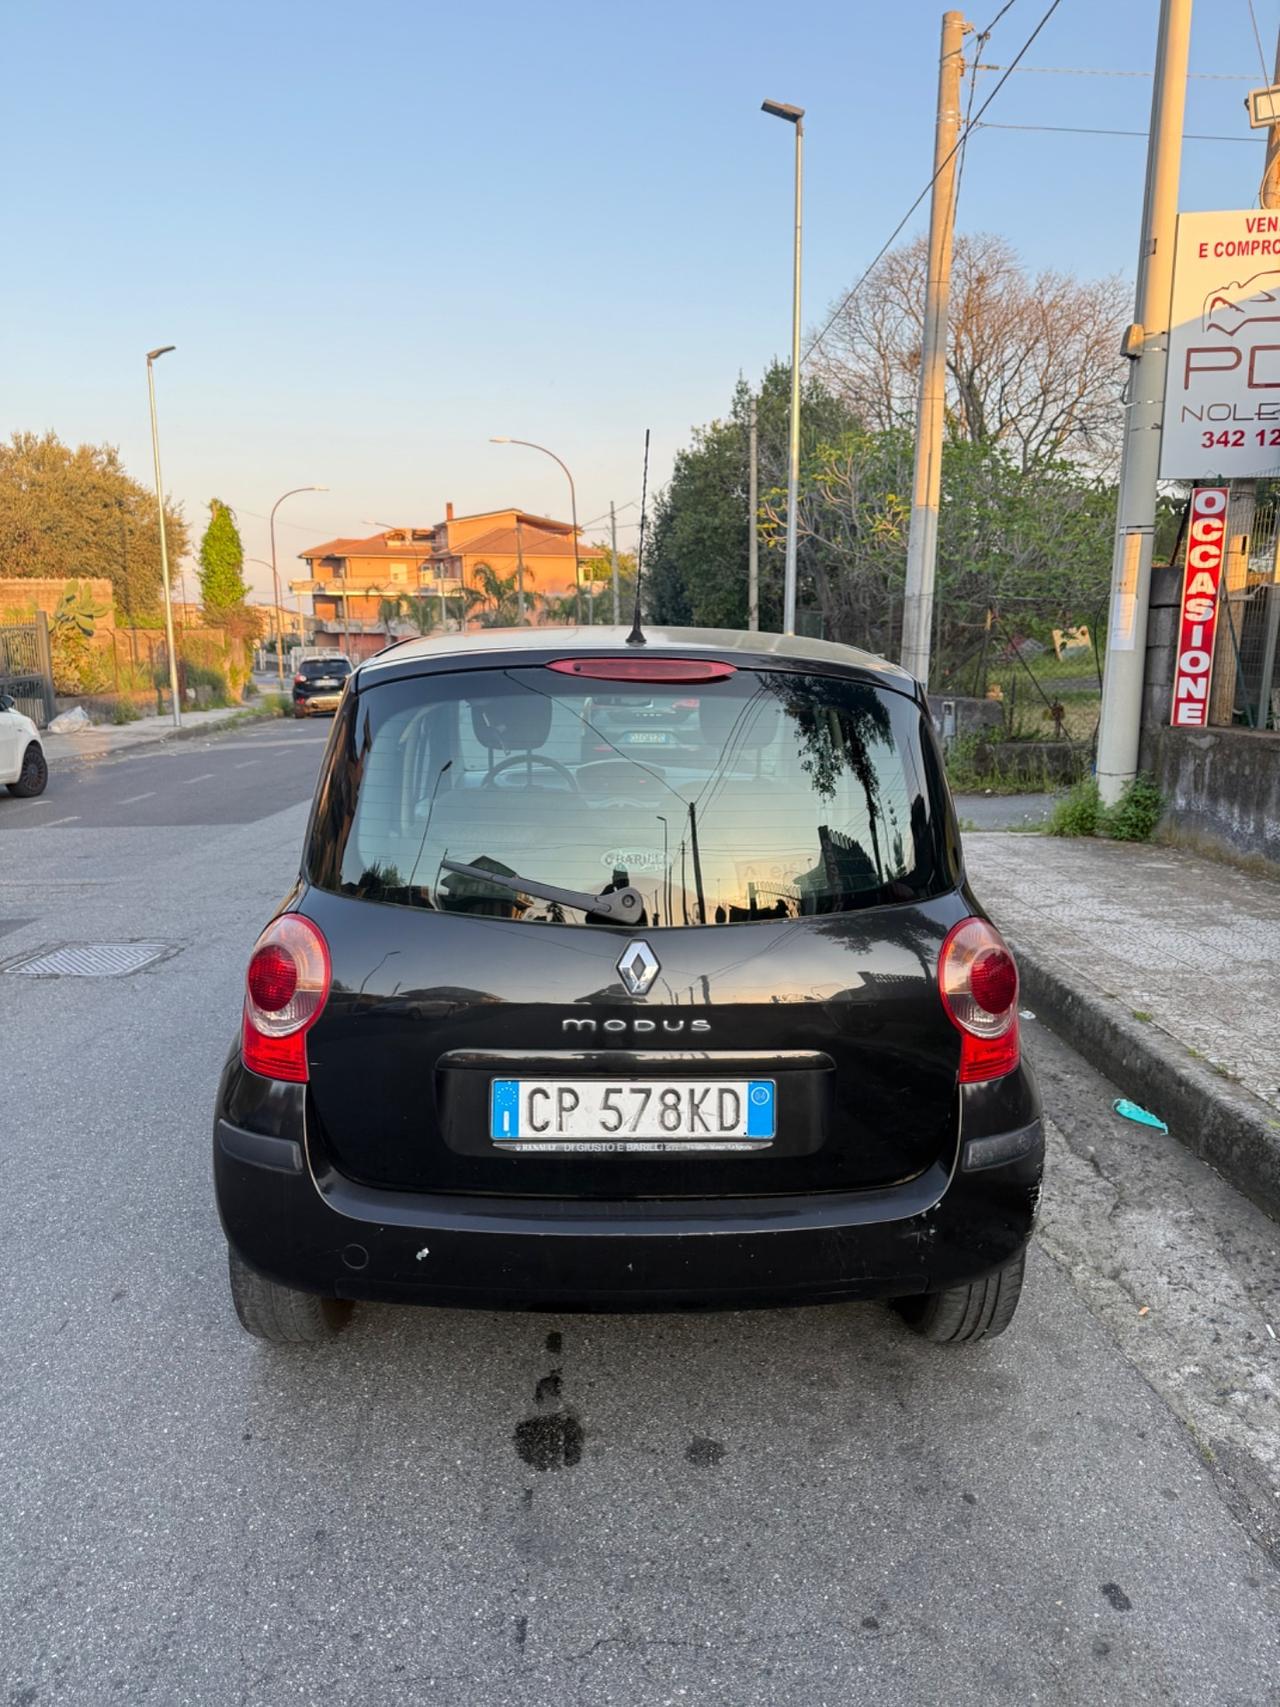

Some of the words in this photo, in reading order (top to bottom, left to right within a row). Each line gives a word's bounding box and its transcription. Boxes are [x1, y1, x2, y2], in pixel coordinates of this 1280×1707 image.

[1246, 216, 1280, 233] VEN
[1199, 242, 1209, 258] E
[1214, 239, 1280, 258] COMPRO
[1201, 429, 1245, 449] 342
[1255, 428, 1280, 447] 12
[1177, 490, 1227, 724] OCCASIONE
[562, 1019, 712, 1032] MODUS
[527, 1087, 580, 1132] CP
[600, 1087, 741, 1132] 578KD
